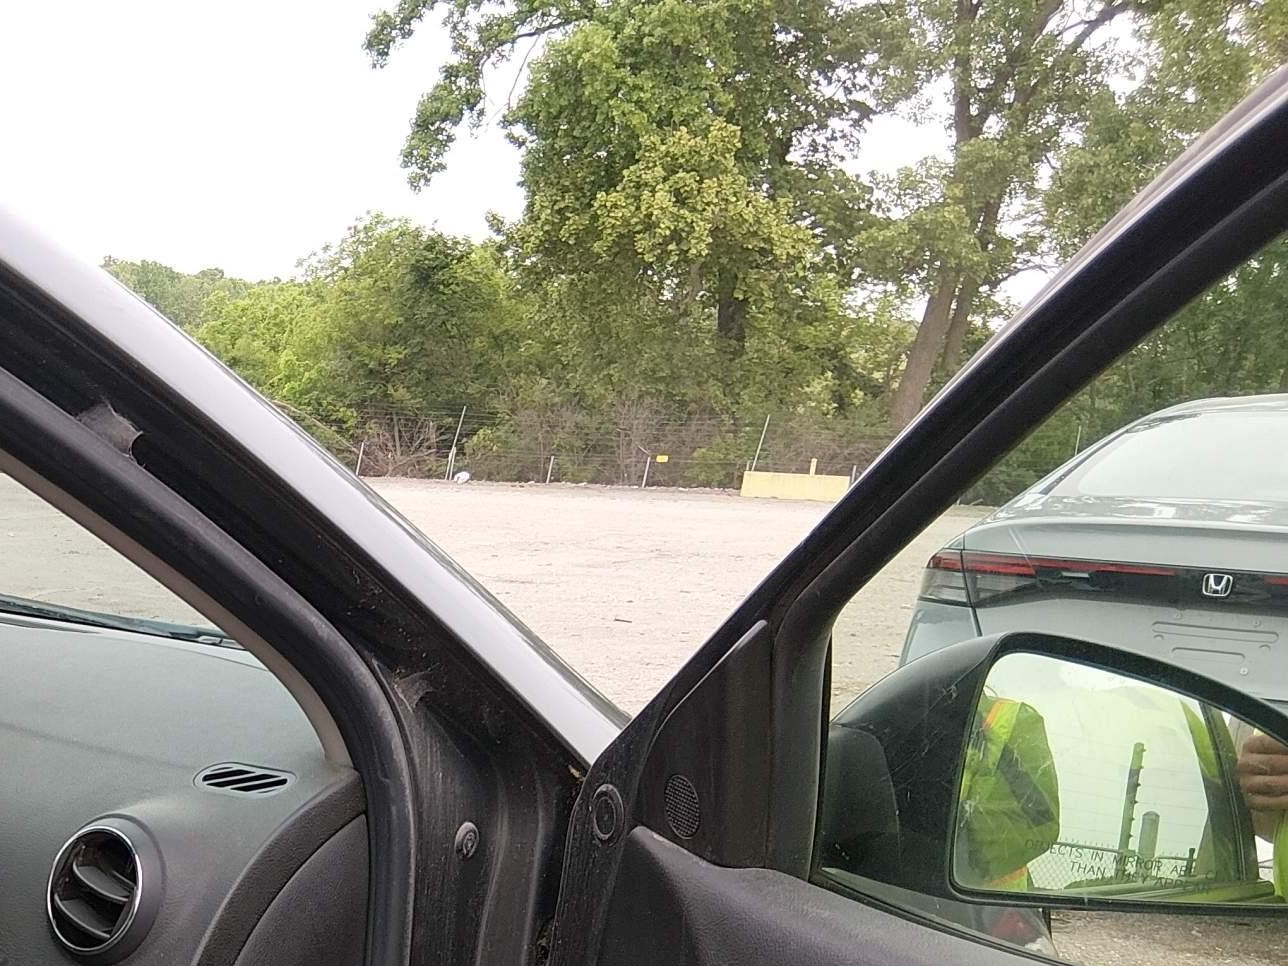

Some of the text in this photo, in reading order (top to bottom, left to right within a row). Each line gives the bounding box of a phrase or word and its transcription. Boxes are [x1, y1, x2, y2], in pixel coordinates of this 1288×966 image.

[1070, 861, 1106, 877] THAN
[1090, 851, 1104, 863] IN
[1112, 854, 1162, 873] MIRROR
